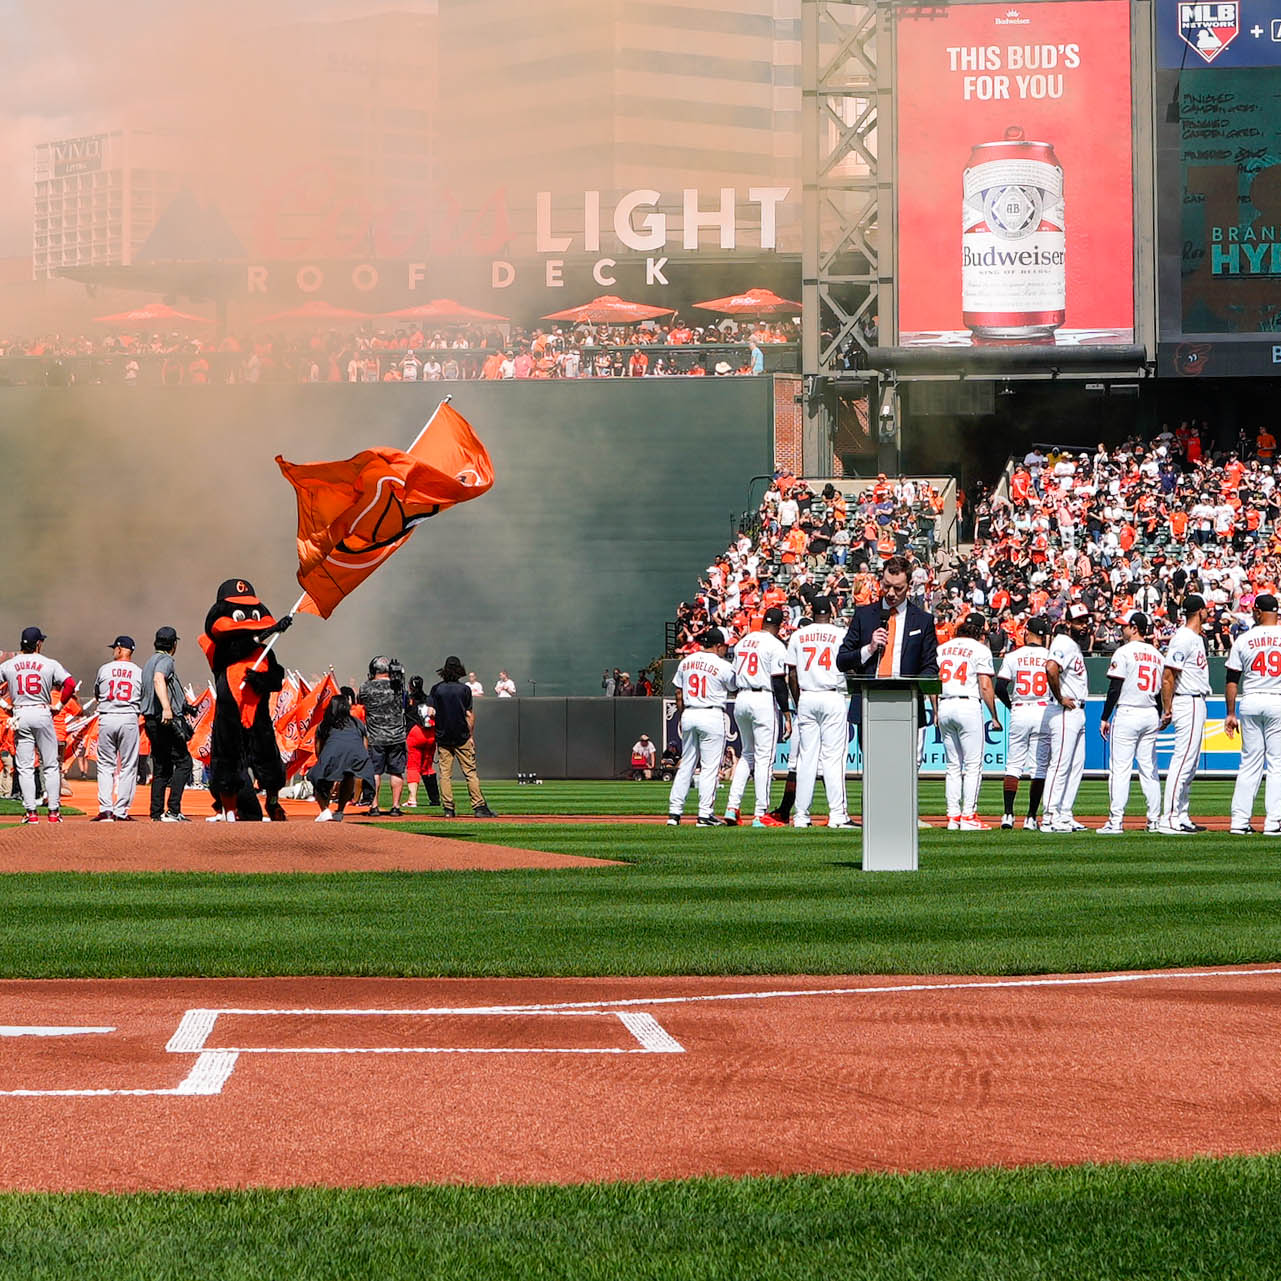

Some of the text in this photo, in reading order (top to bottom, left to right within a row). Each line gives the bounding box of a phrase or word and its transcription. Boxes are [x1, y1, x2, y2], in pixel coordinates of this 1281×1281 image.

[1182, 4, 1236, 22] MLB
[1182, 21, 1236, 29] NETWORK
[946, 44, 1081, 72] THIS BUD'S
[963, 74, 1064, 101] FOR YOU
[536, 187, 791, 252] LIGHT
[963, 244, 1065, 267] Budweiser
[247, 257, 669, 294] ROOF DECK
[799, 633, 837, 644] BAUTISTA
[14, 659, 44, 672] DURAN
[737, 651, 759, 677] 78
[802, 646, 832, 671] 74
[1017, 657, 1048, 667] PEREZ
[16, 673, 43, 696] 16
[111, 668, 133, 679] CORA
[939, 659, 968, 686] 64
[1015, 670, 1049, 697] 58
[1137, 665, 1157, 693] 51
[108, 679, 133, 702] 13
[687, 673, 707, 699] 91
